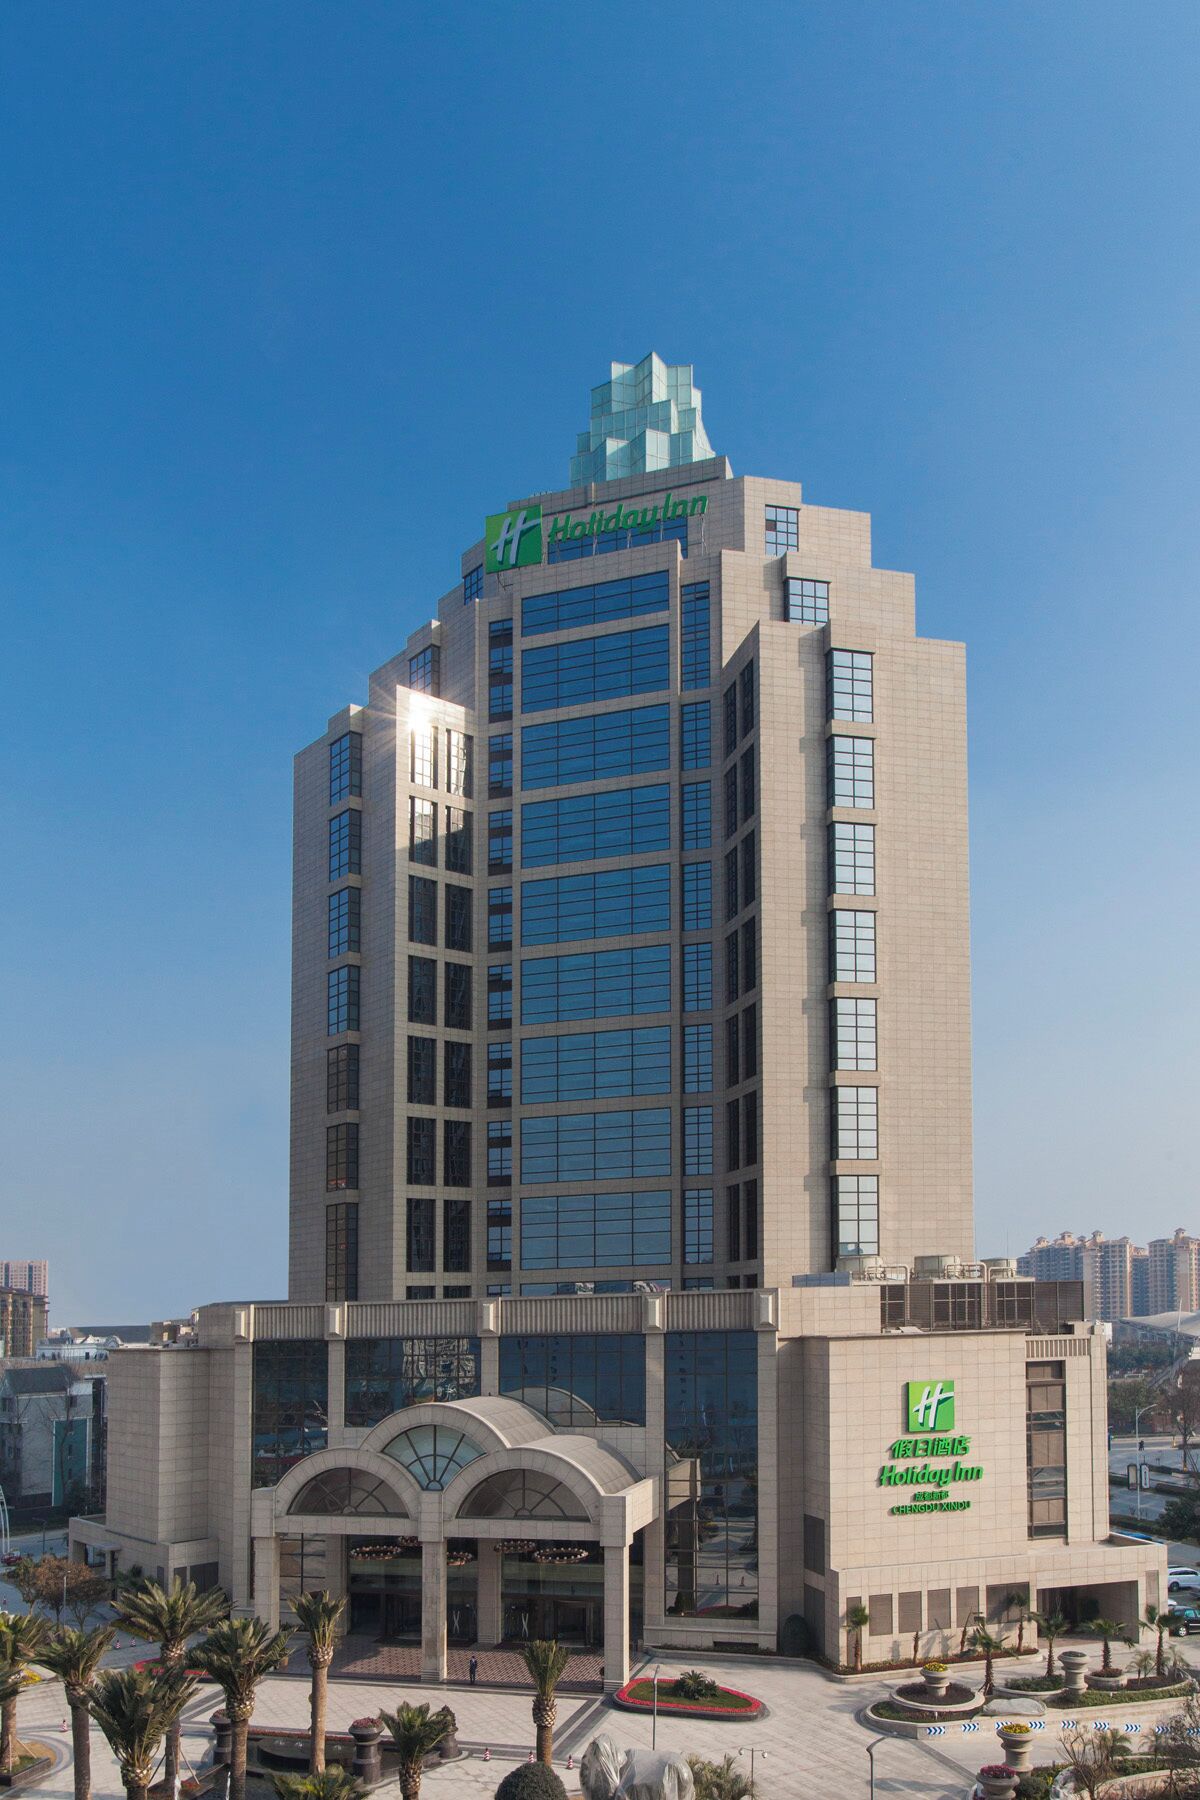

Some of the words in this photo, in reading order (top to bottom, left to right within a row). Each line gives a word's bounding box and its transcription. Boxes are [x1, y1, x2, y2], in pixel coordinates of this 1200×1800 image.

[548, 503, 657, 544] Holiday
[661, 492, 709, 520] Inn
[890, 1436, 971, 1459] 假日酒店
[880, 1463, 953, 1487] Holiday
[954, 1461, 984, 1481] Inn
[892, 1502, 940, 1516] CHENGDU
[941, 1500, 972, 1513] XINDU
